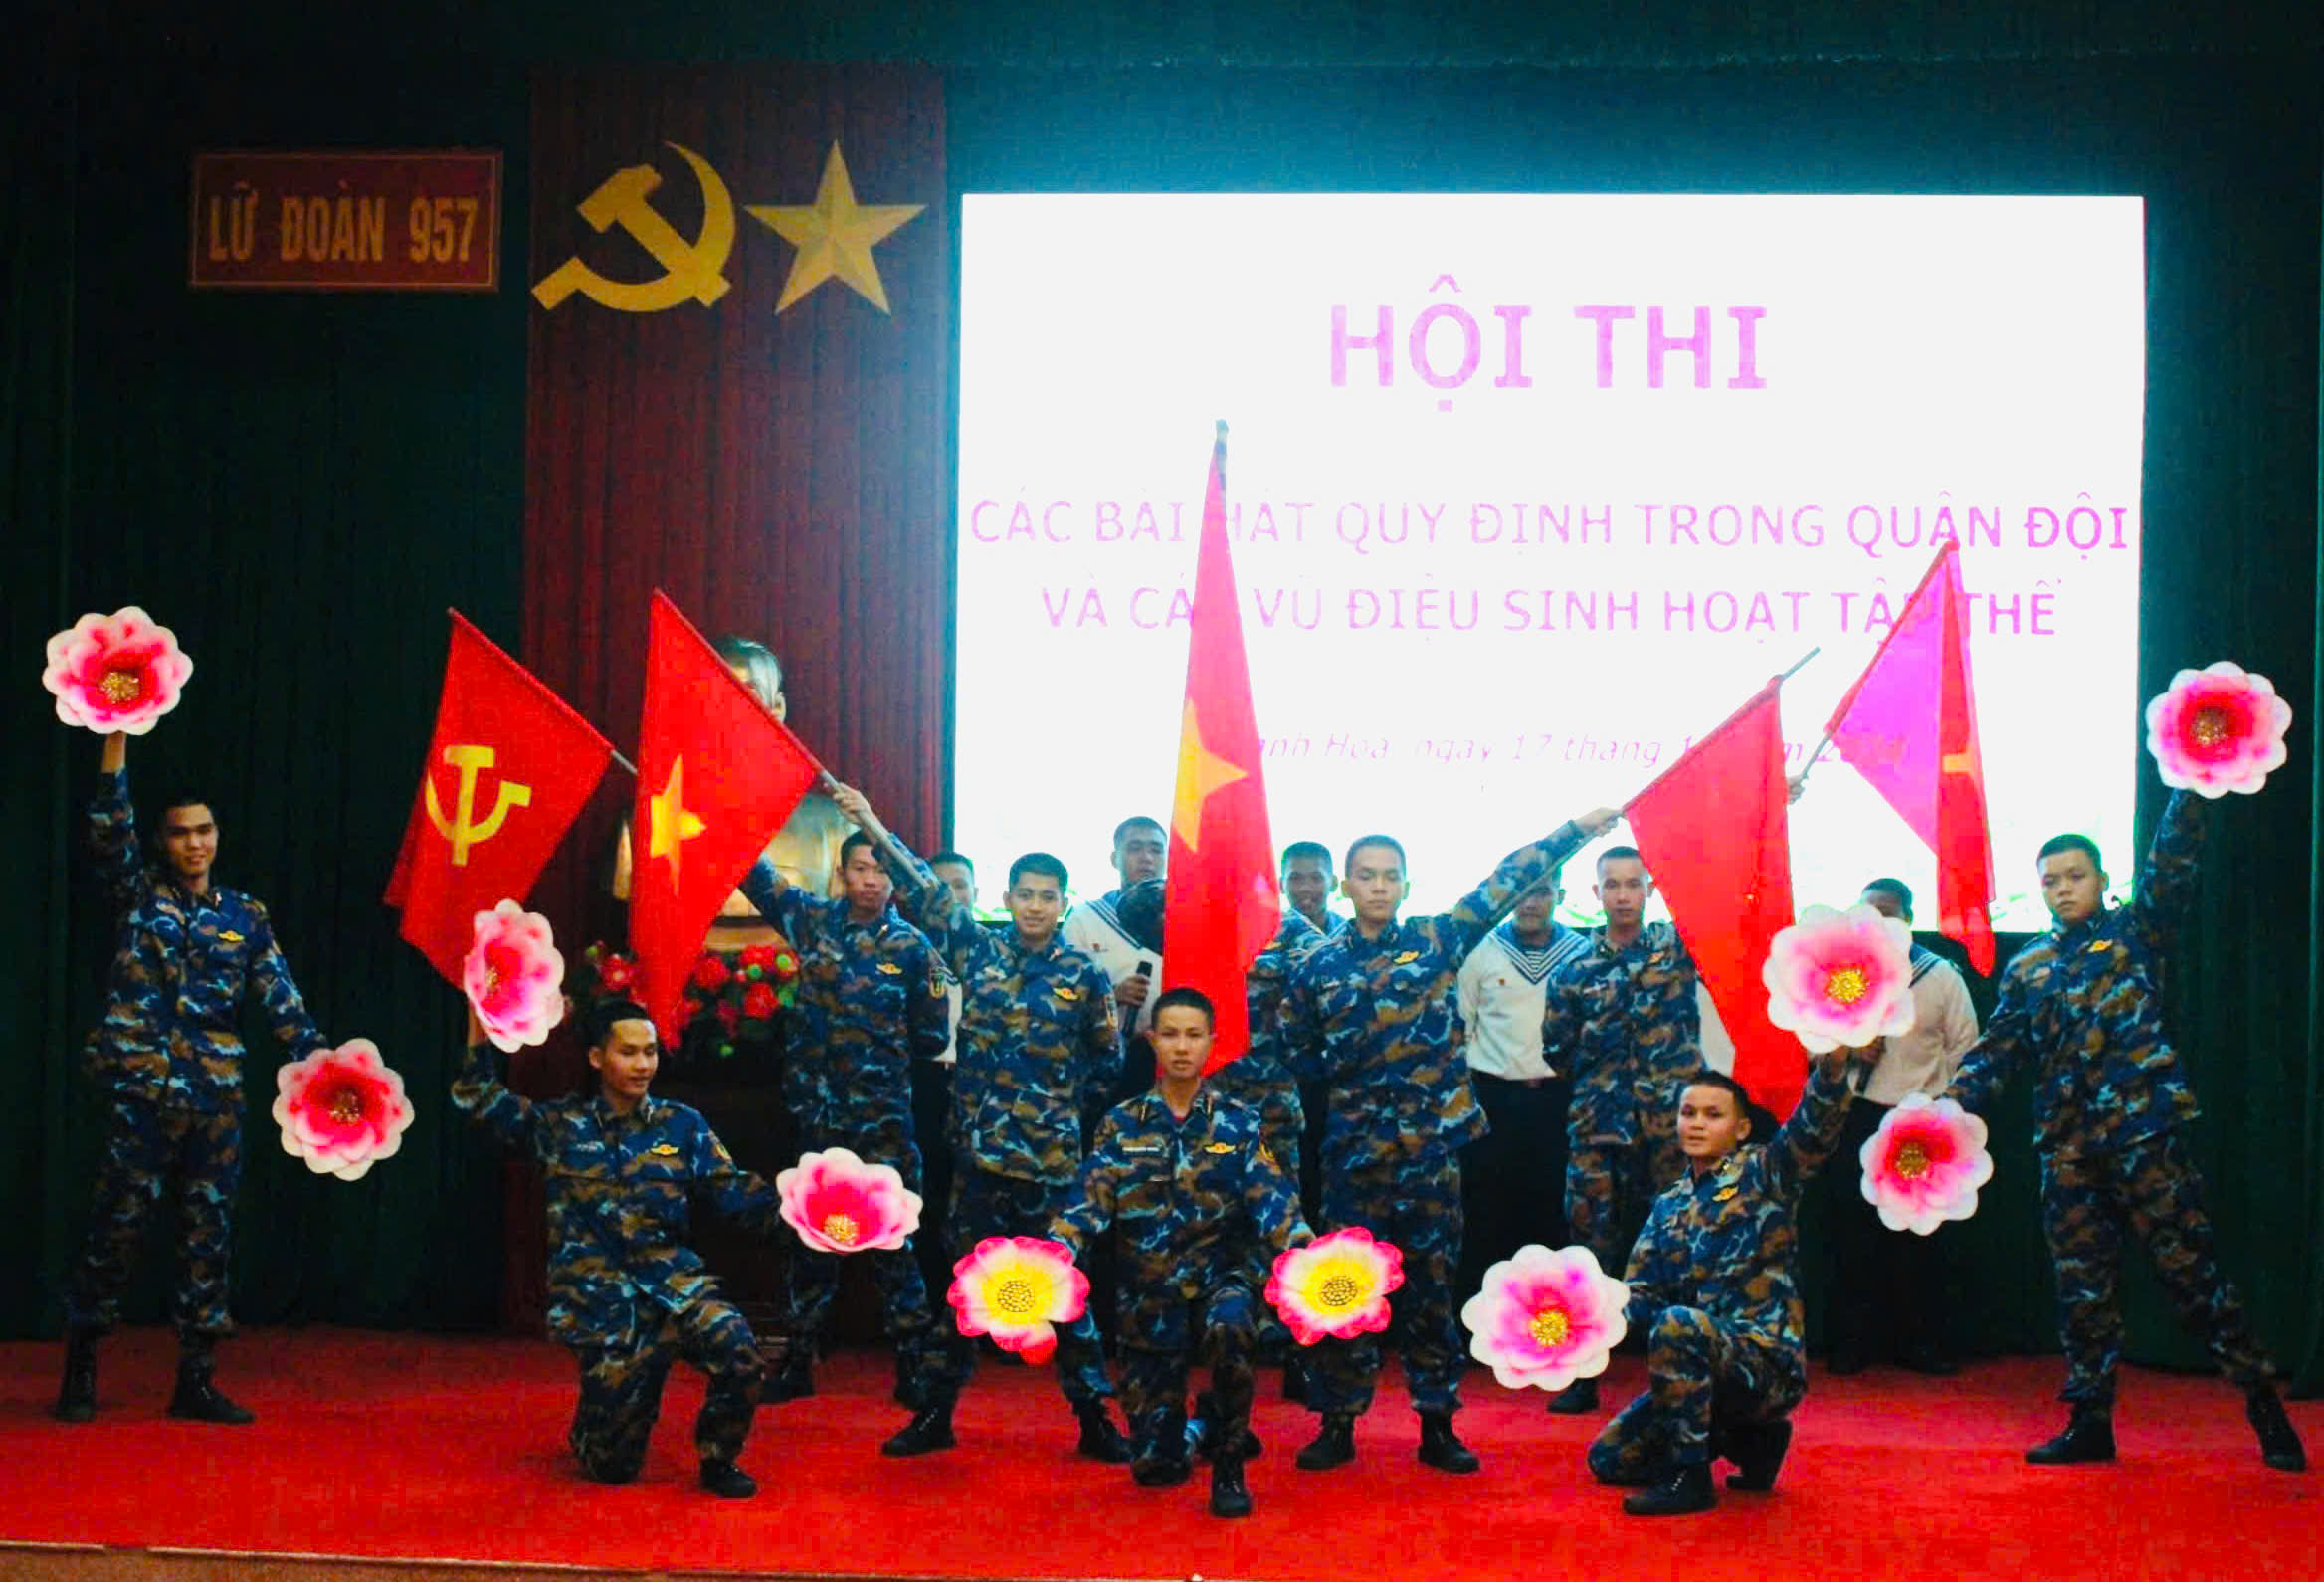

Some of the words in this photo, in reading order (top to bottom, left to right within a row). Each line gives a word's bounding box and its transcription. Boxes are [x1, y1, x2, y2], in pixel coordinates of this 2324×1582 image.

[280, 179, 385, 262] ĐOÀN
[409, 195, 478, 263] 957
[1330, 273, 1533, 412] HỘI
[1574, 305, 1768, 389] THI
[970, 485, 1072, 542] CÁC
[1335, 501, 1447, 555] QUY
[1467, 501, 1612, 556] ĐỊNH
[1633, 503, 1825, 547] TRONG
[1846, 490, 2002, 558] QUÂN
[2023, 491, 2129, 561] ĐỘI
[1041, 571, 1108, 629] VÀ
[1503, 587, 1639, 631] SINH
[1663, 589, 1812, 645] HOẠT
